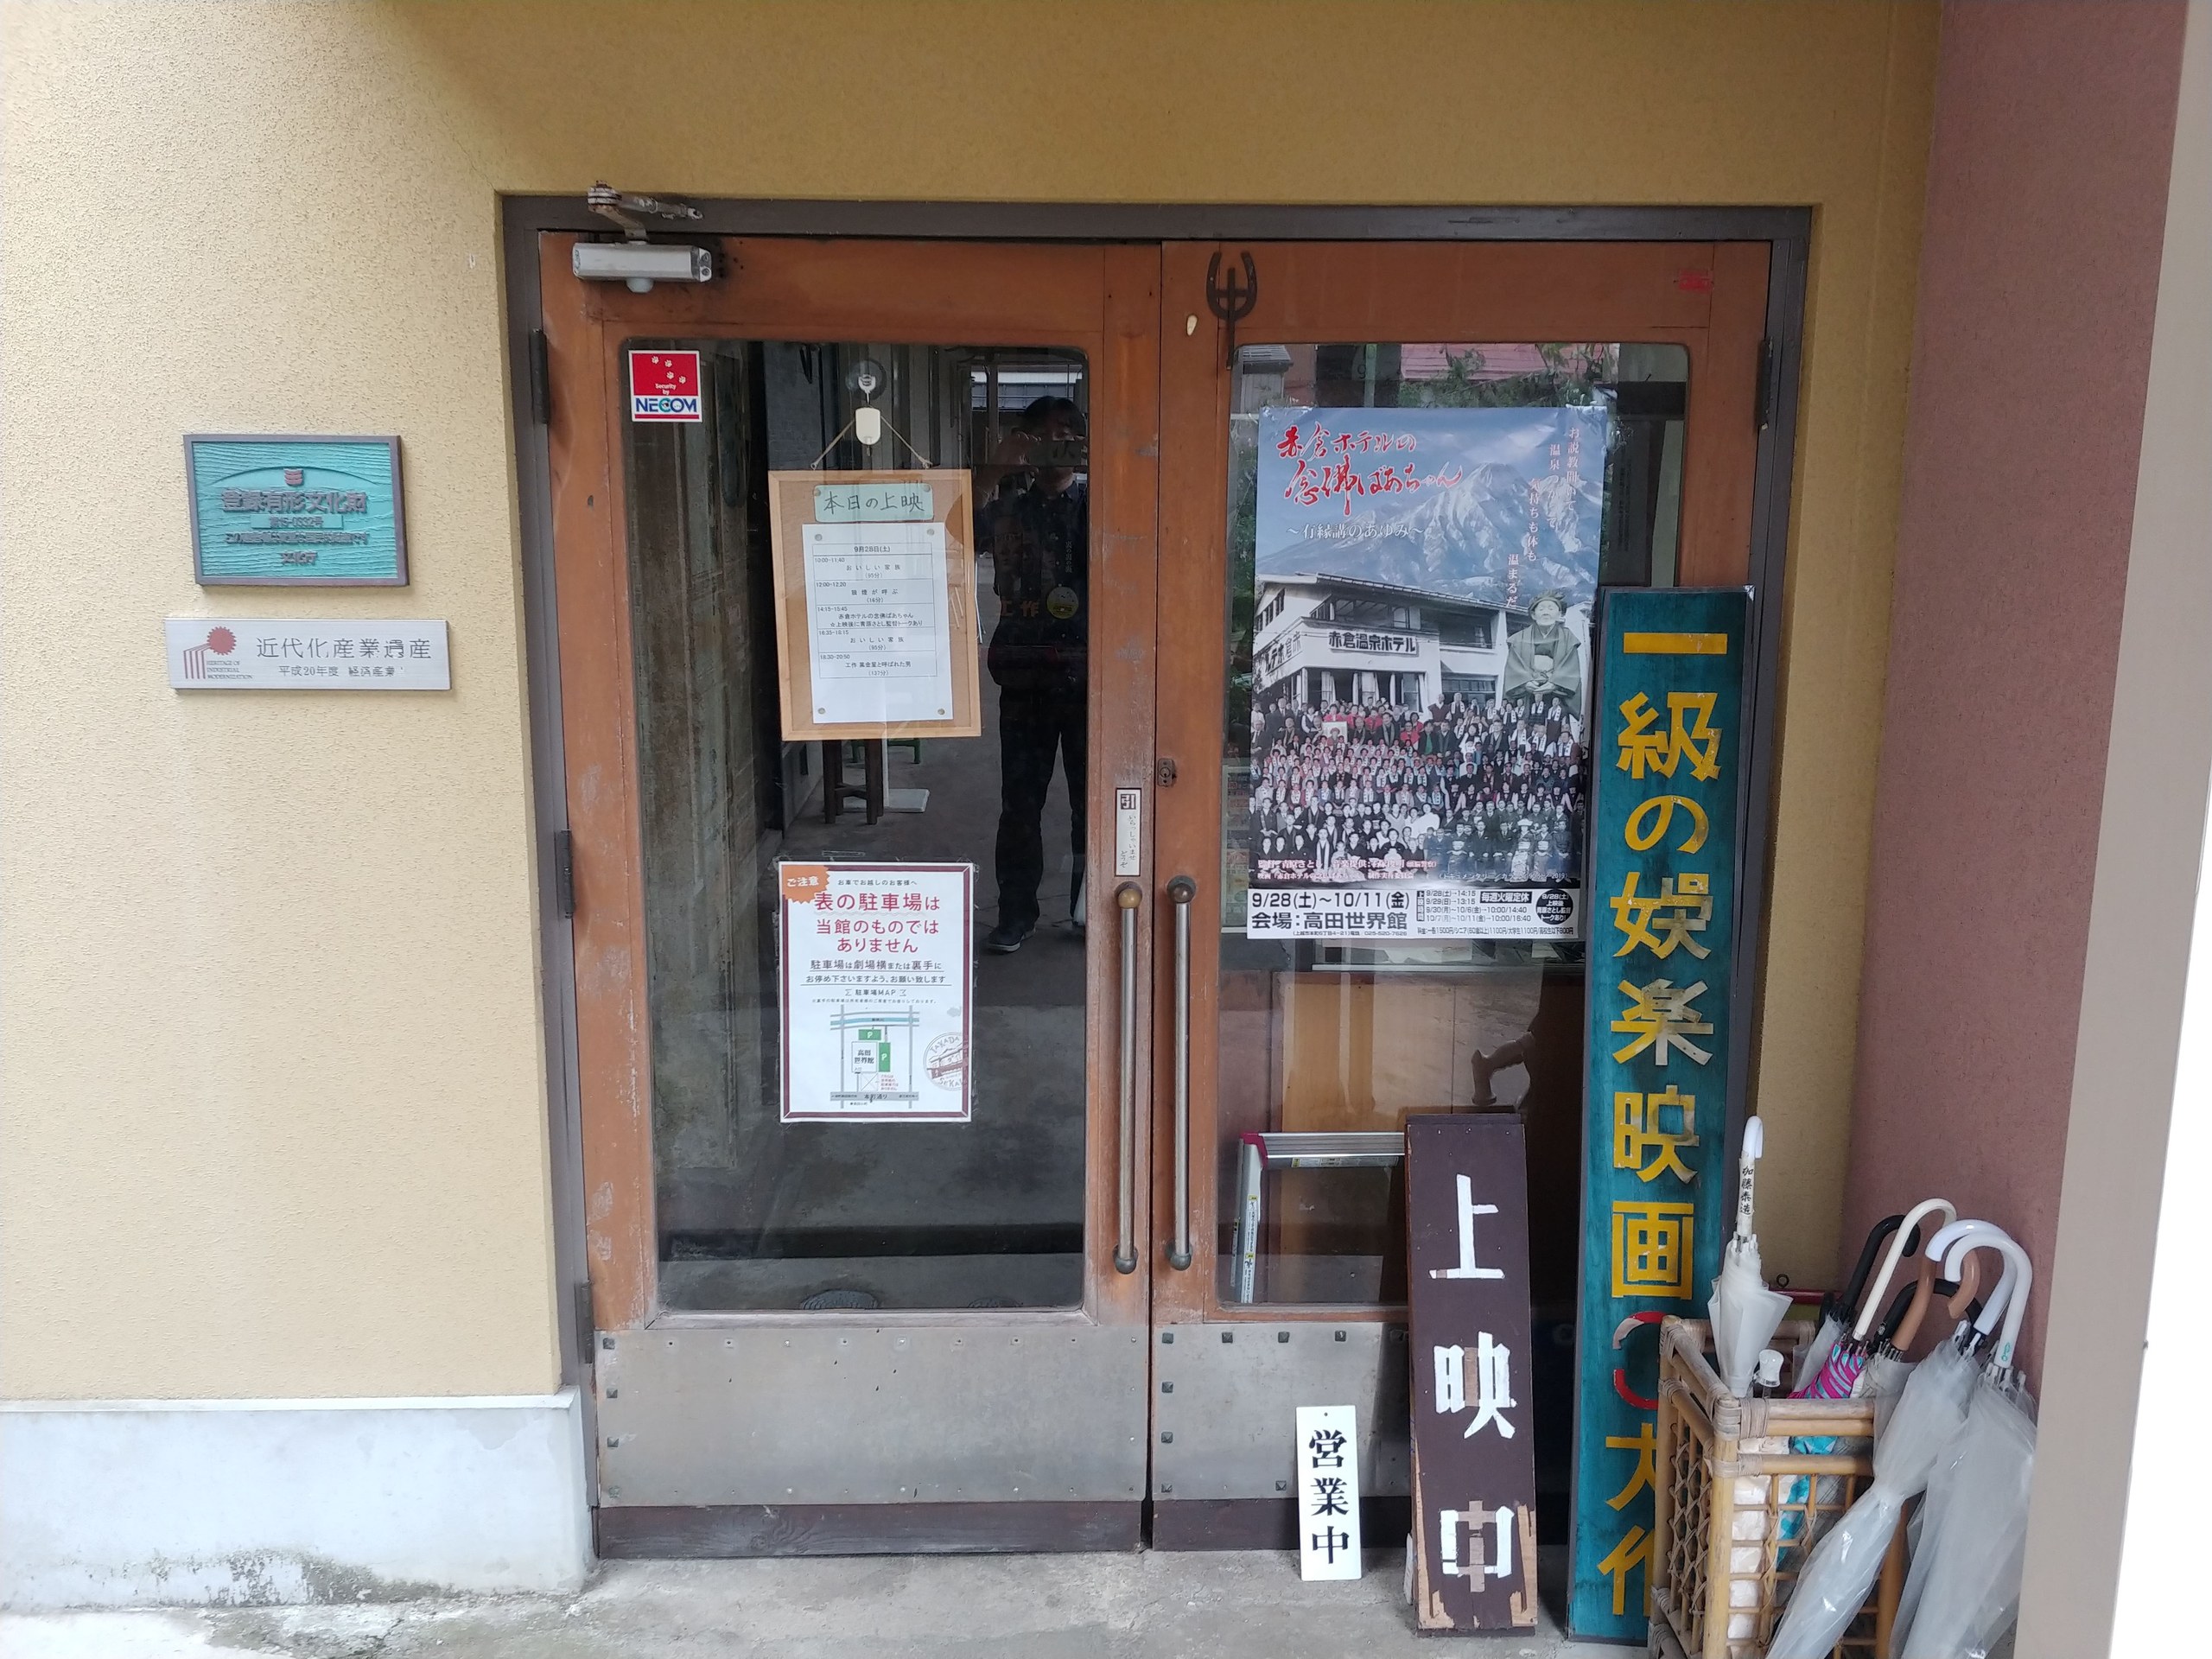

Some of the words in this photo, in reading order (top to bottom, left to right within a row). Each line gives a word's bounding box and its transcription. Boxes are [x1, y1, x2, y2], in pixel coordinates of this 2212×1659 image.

[635, 397, 697, 412] NECOM
[1276, 422, 1417, 461] 赤倉ホテルの
[221, 490, 368, 513] 登録有形文化財
[823, 490, 925, 515] 本日の上映
[257, 638, 432, 659] 近代化産業遺産
[1329, 630, 1416, 652] 赤倉温泉ホテル
[279, 666, 340, 677] 平成20年度
[348, 666, 404, 677] 経済産業
[787, 876, 820, 887] ご注意
[814, 893, 940, 912] 表の駐車場は
[1481, 892, 1529, 903] 毎週火曜定休
[817, 918, 939, 935] 当館のものでは
[1251, 912, 1408, 930] 会場:高田世界館
[837, 938, 918, 953] ありません
[810, 959, 942, 970] 駐車場は劇場横または裏手に
[805, 975, 946, 983] お停め下さいますよう、お願い致します
[1429, 1173, 1516, 1593] 上映中
[1308, 1428, 1350, 1565] 営業中
